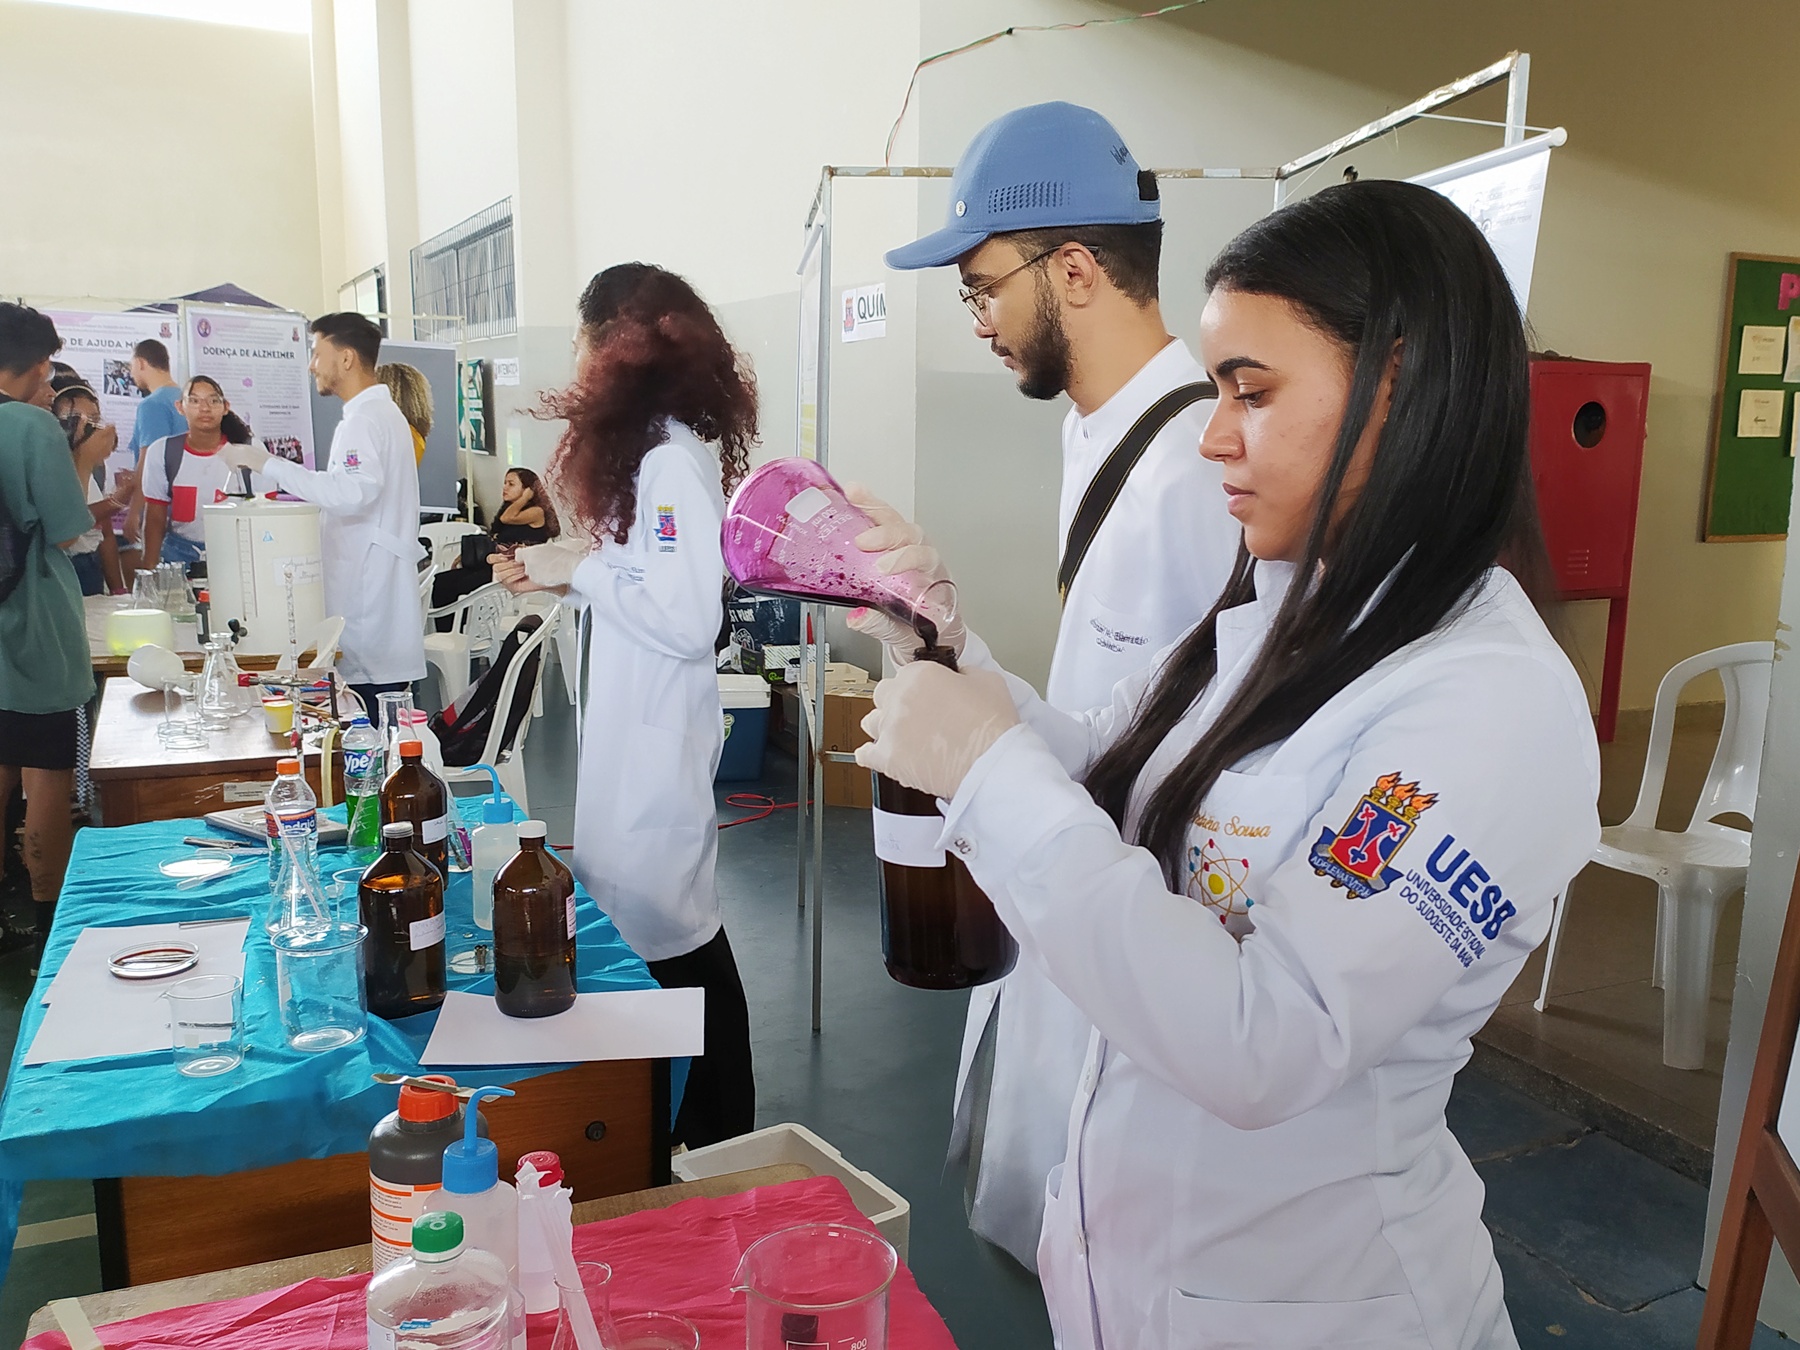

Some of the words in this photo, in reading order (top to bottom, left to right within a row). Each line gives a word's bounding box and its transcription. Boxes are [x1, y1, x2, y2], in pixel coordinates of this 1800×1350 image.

[70, 338, 83, 347] DE
[87, 338, 123, 348] AJUDA
[203, 346, 238, 358] DOENÇA
[240, 349, 250, 357] DE
[1224, 815, 1271, 838] Sousa
[1405, 868, 1467, 932] UNIVERSIDADE
[1425, 834, 1517, 940] UESB
[1399, 885, 1418, 904] DO
[1416, 900, 1456, 944] SUDOESTE
[1449, 938, 1460, 953] DA
